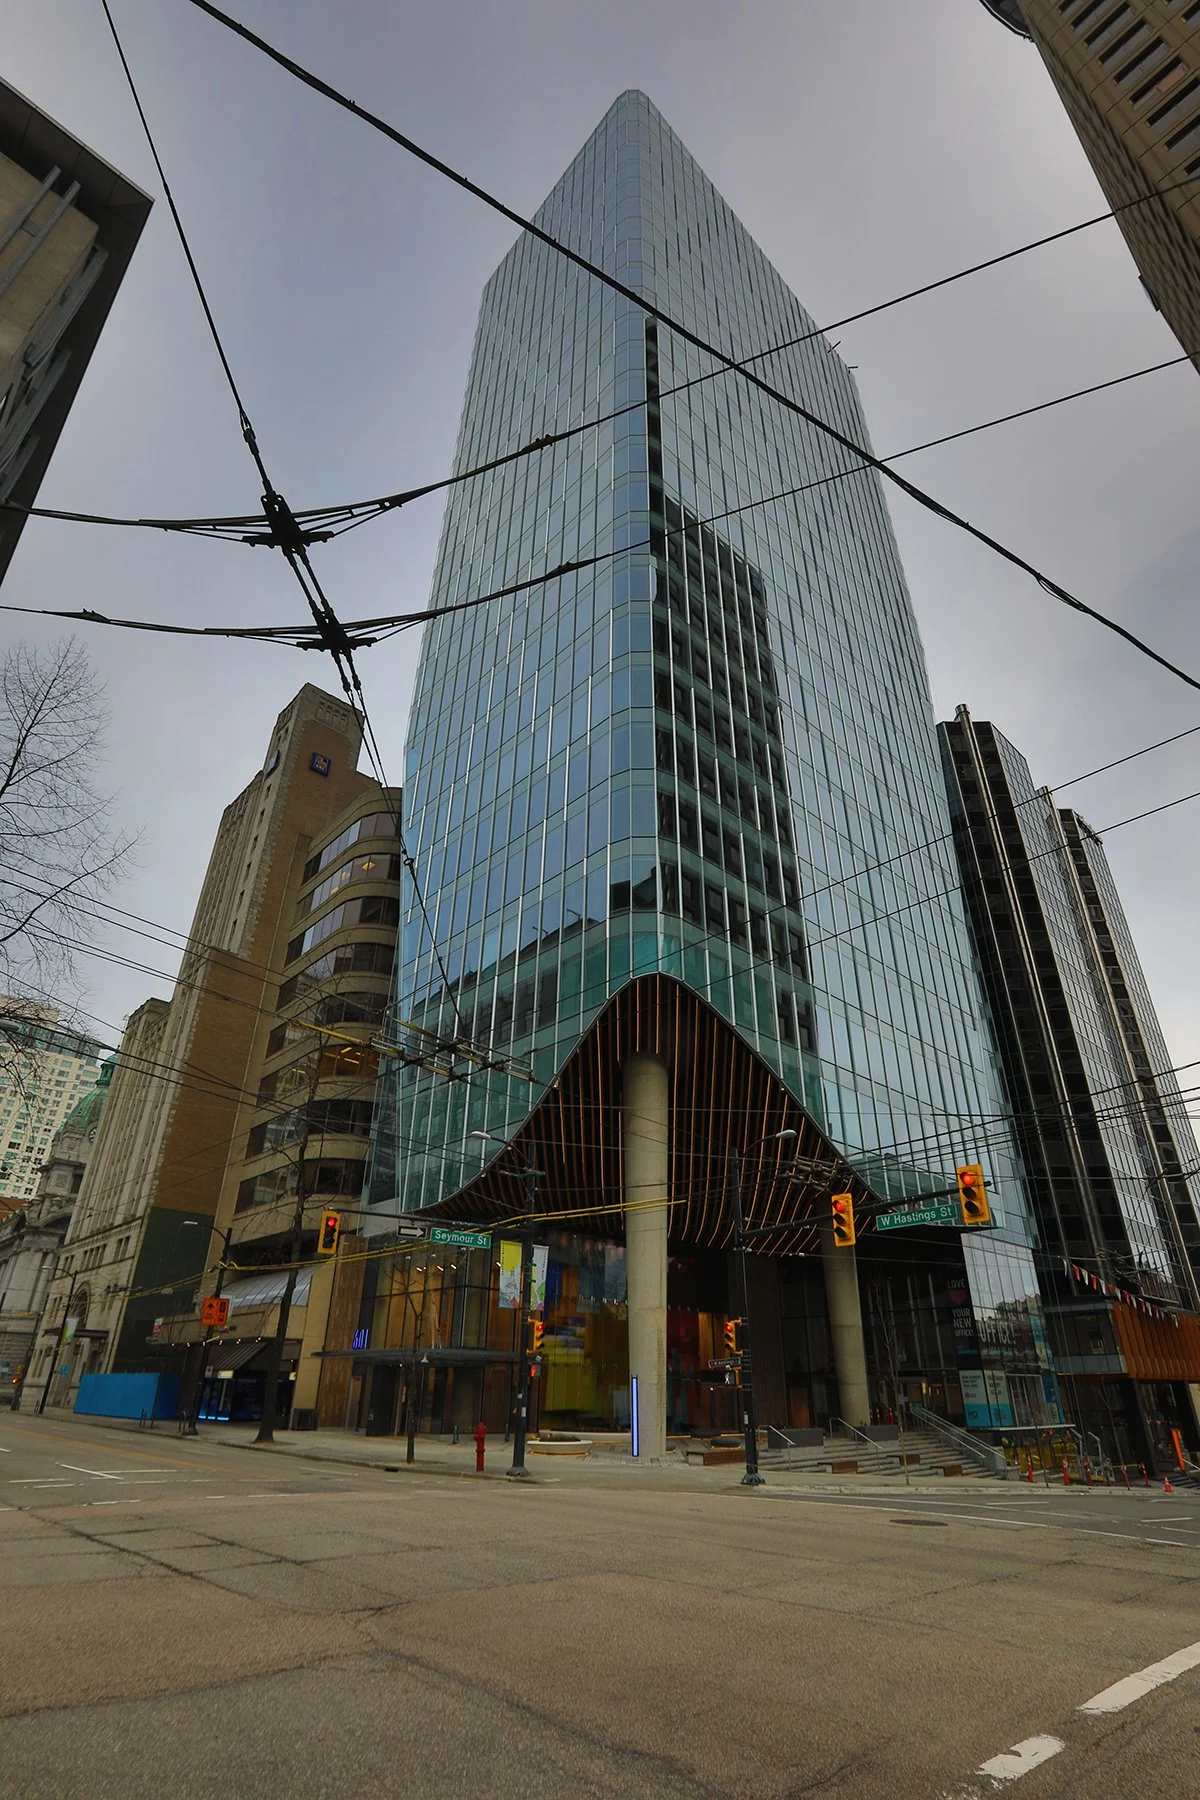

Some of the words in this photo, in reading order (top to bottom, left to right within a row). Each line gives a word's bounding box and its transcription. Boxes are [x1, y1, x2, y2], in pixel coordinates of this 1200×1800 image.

[880, 1216, 890, 1226] W
[894, 1210, 936, 1225] Hastings
[940, 1206, 952, 1217] St
[435, 1229, 474, 1243] Seymour
[477, 1235, 487, 1245] St
[947, 1279, 965, 1289] LOVE
[952, 1308, 971, 1318] YOUR
[953, 1317, 972, 1329] NEW
